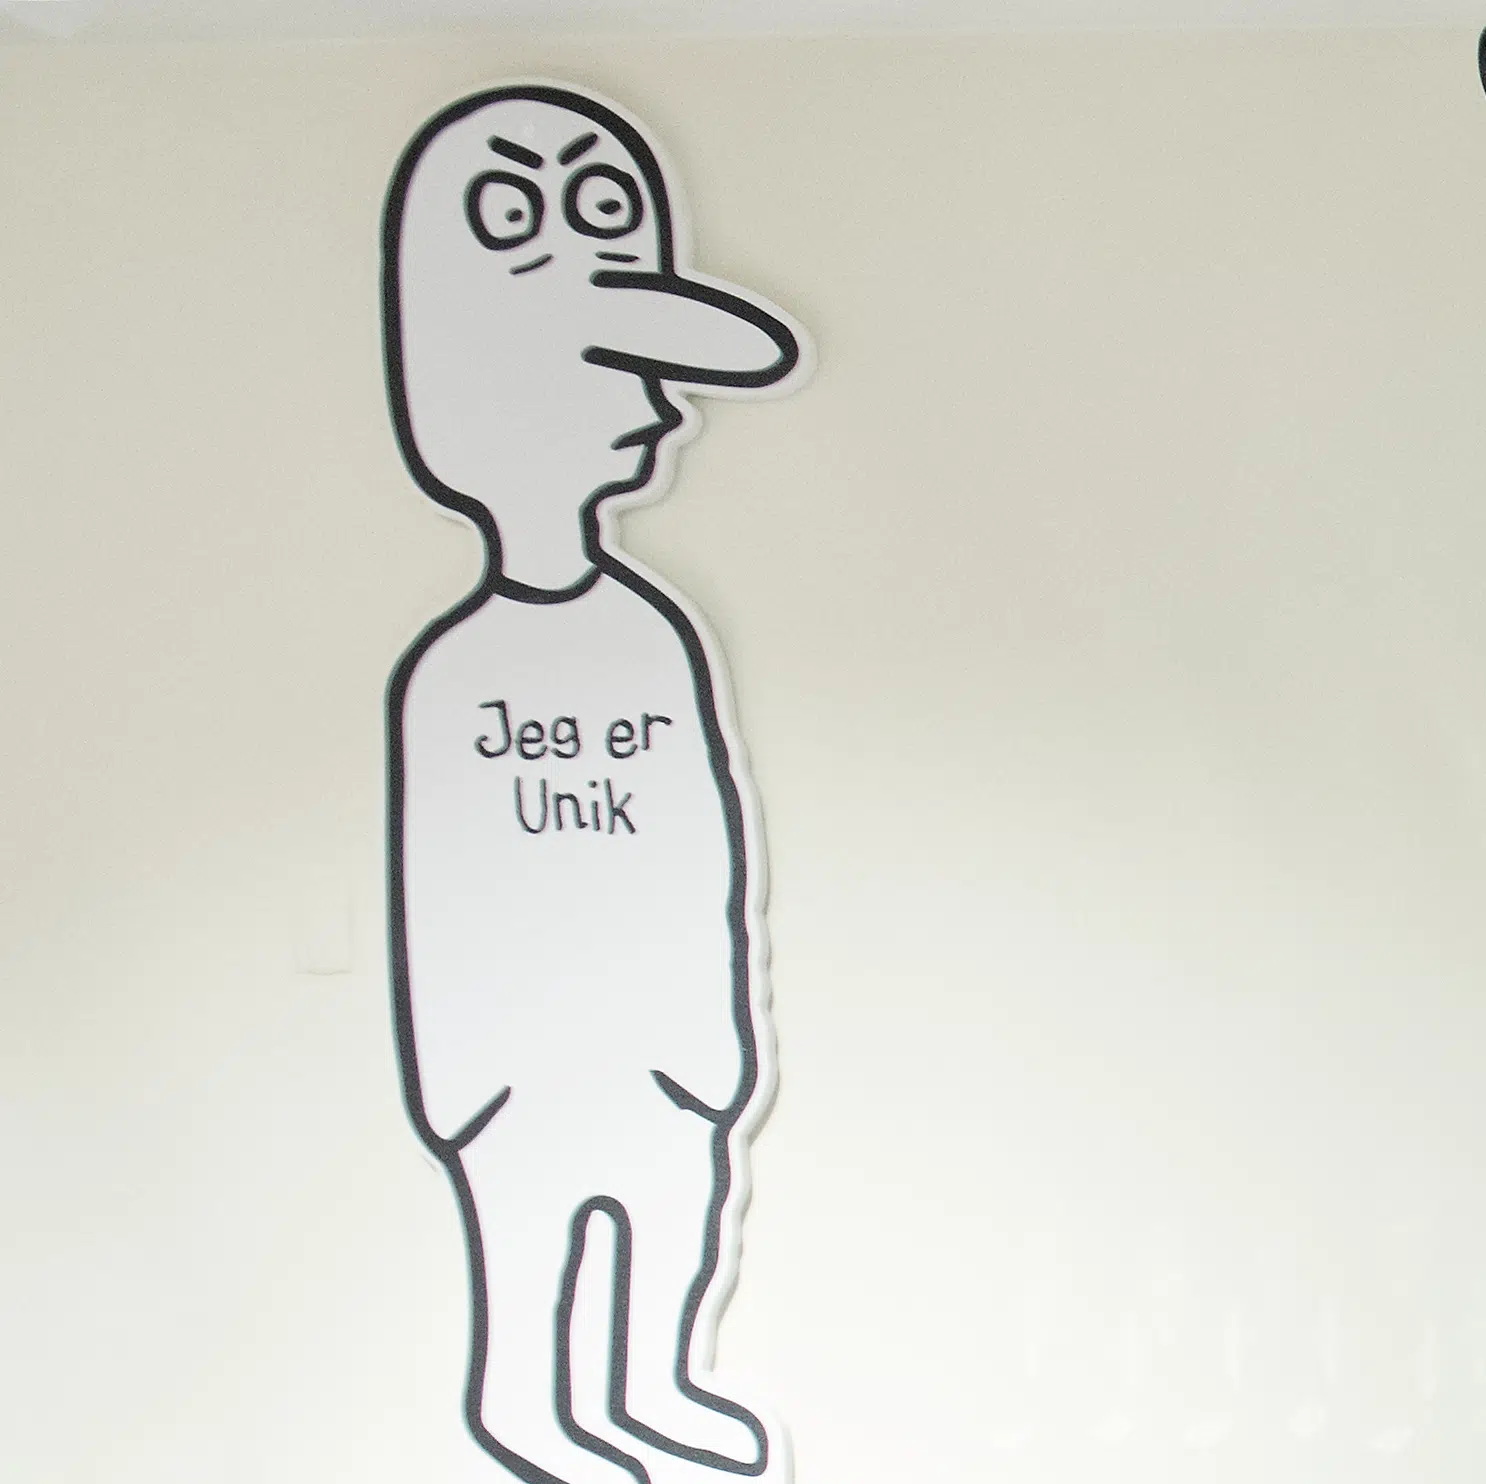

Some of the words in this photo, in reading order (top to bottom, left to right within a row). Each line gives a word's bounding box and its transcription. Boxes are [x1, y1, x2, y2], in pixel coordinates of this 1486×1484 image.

[474, 699, 581, 760] Jeg
[605, 712, 673, 759] er
[513, 776, 636, 835] Unik
